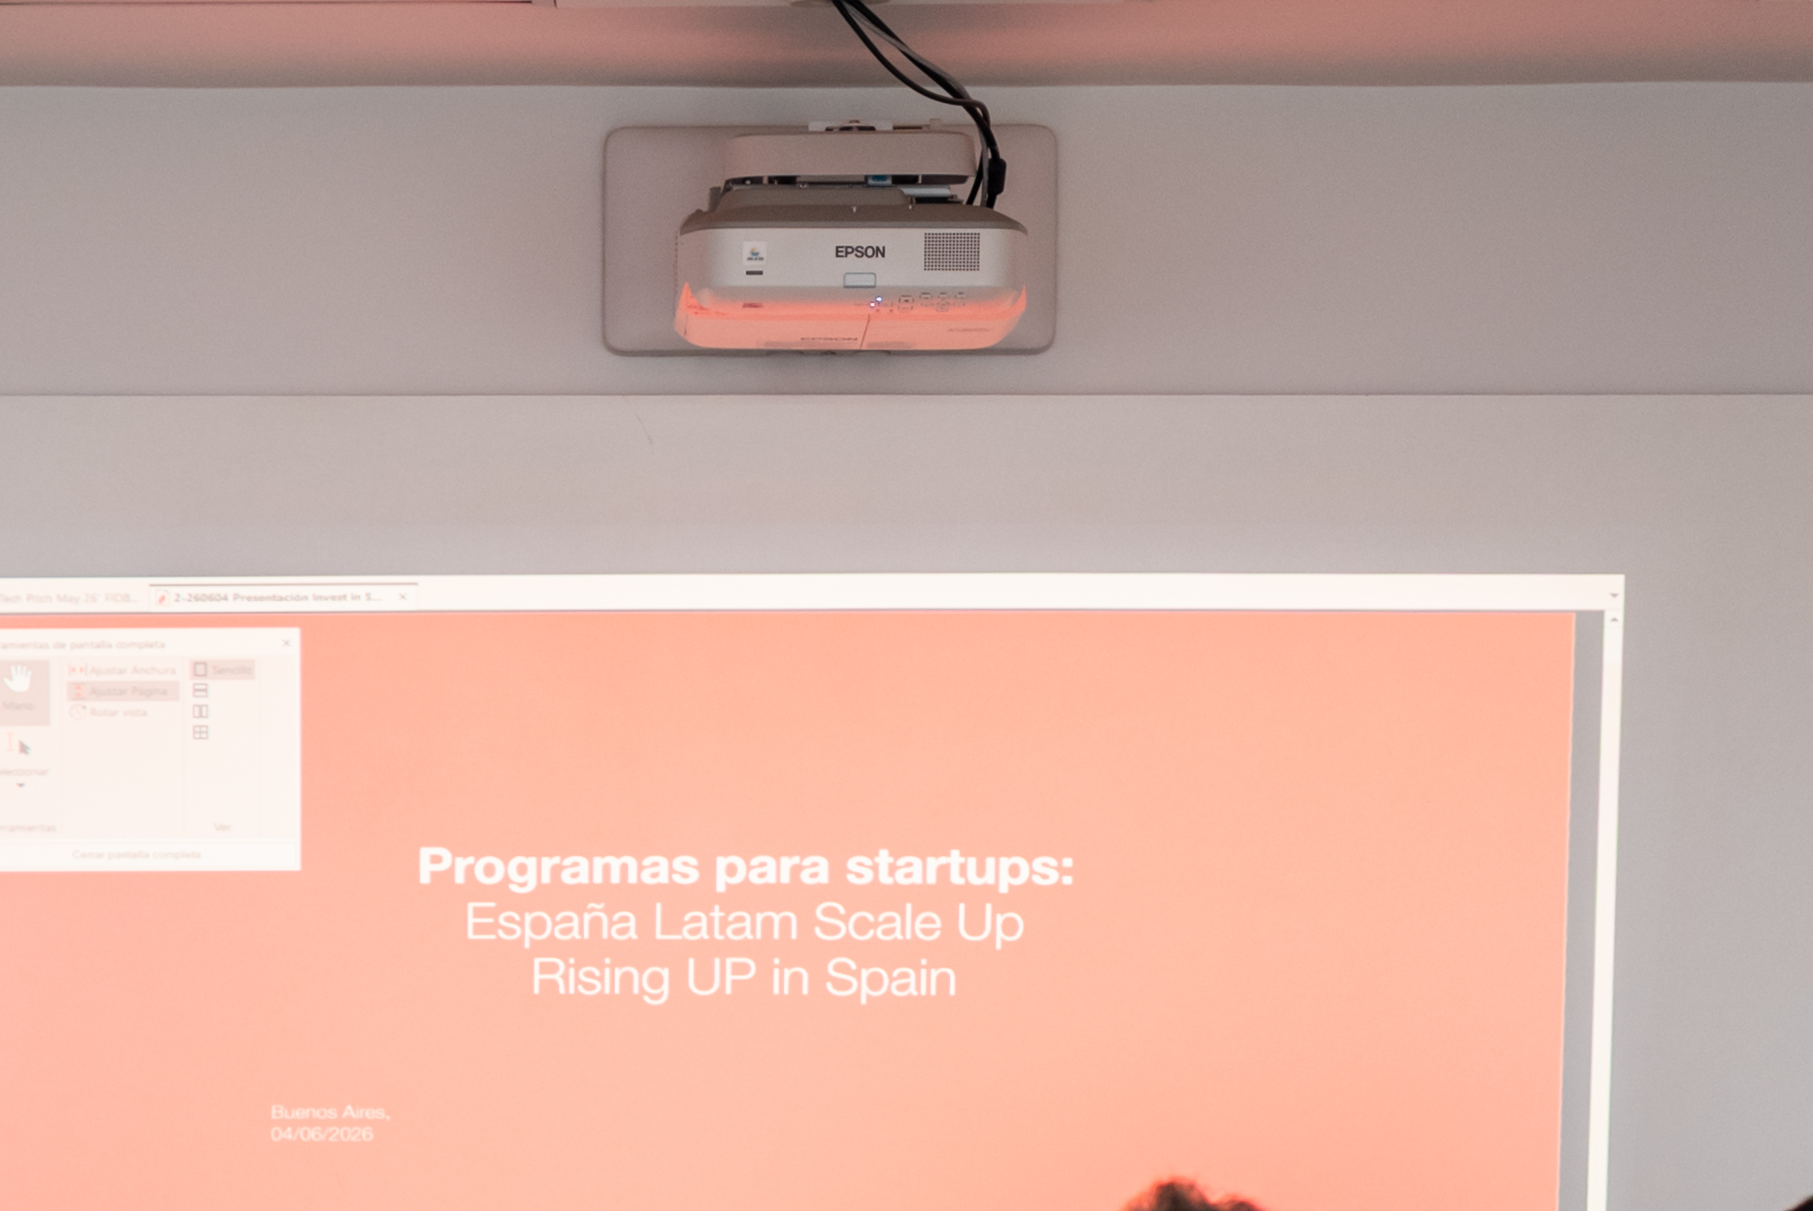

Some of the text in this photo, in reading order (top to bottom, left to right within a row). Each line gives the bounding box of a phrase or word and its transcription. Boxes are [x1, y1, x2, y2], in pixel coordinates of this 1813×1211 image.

[835, 245, 886, 259] EPSON
[55, 593, 81, 605] May
[232, 592, 309, 603] Presentación
[311, 593, 348, 602] Invest
[350, 593, 362, 602] in
[52, 641, 67, 650] de
[69, 640, 113, 651] pantalla
[115, 641, 166, 651] completa
[88, 665, 177, 677] Ajustar Anchura
[89, 686, 128, 698] Ajustar
[89, 707, 149, 718] Rotar vista
[213, 823, 231, 832] Ver
[72, 849, 202, 861] Cerrar pantalla completa
[419, 847, 1073, 893] Programas para startups:
[467, 902, 1025, 950] España Latam Scale Up
[534, 957, 956, 1004] Rising UP in Spain
[271, 1105, 391, 1120] Buenos Aires,
[271, 1127, 374, 1141] 04/06/2026
